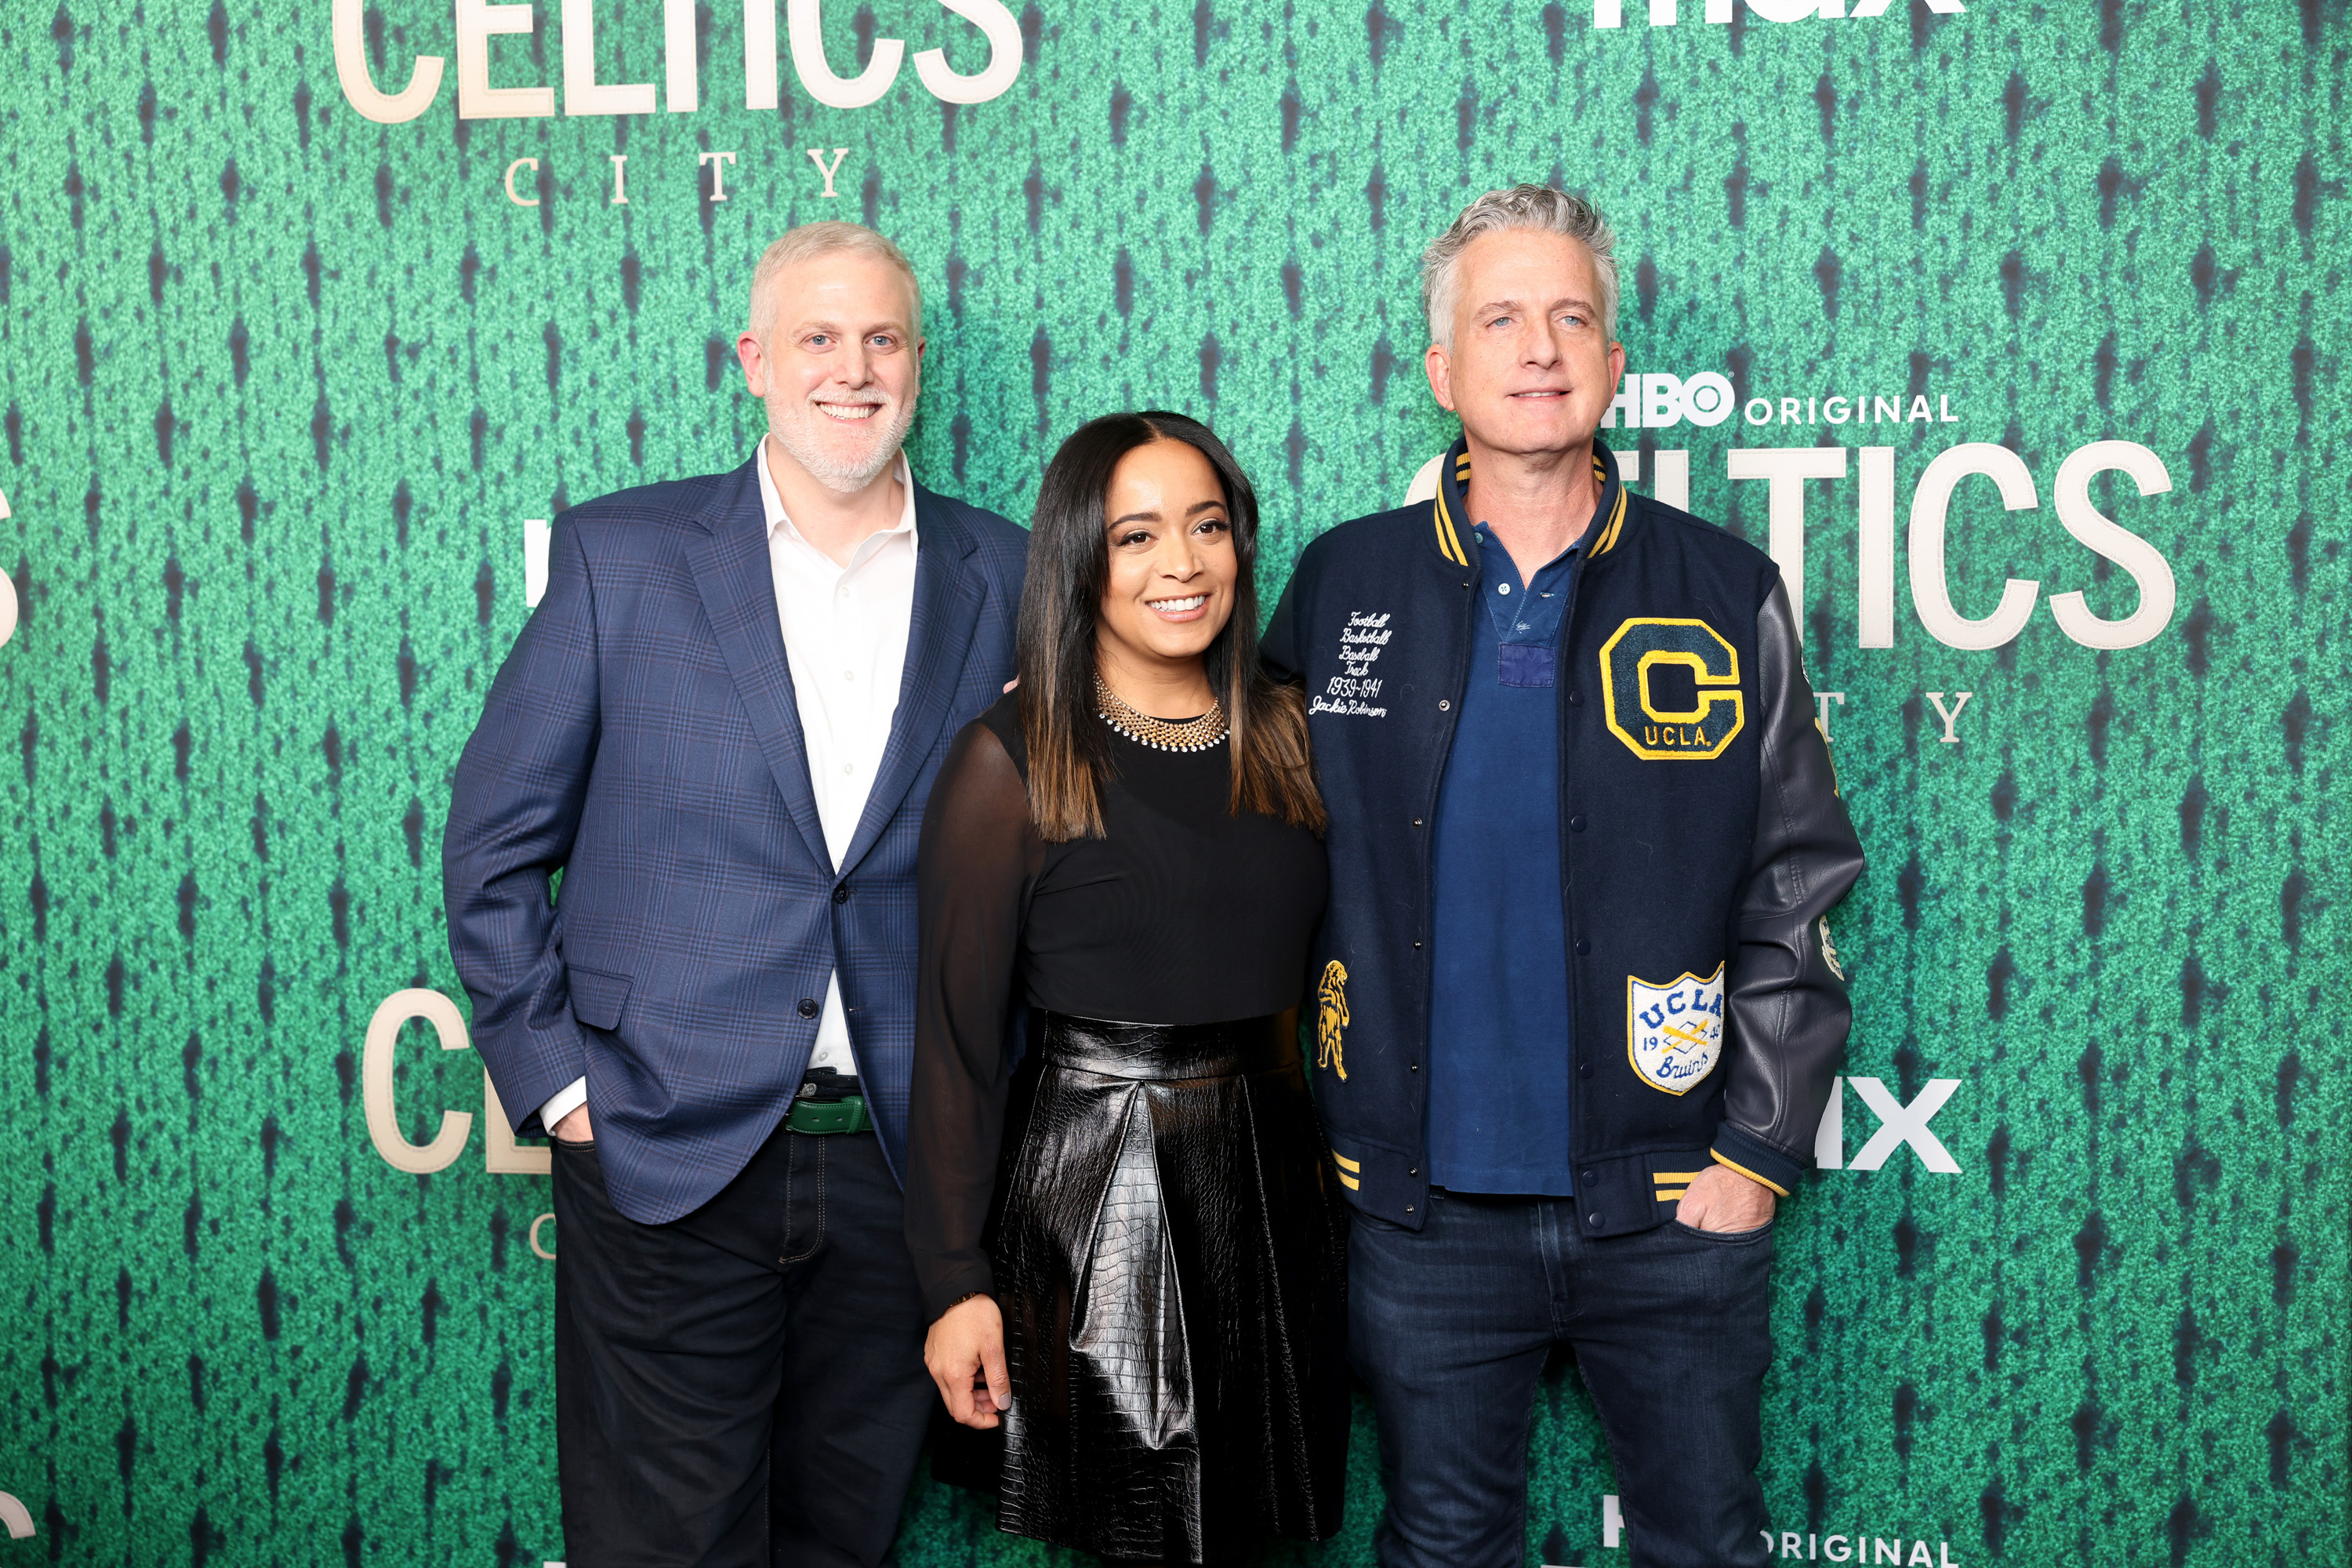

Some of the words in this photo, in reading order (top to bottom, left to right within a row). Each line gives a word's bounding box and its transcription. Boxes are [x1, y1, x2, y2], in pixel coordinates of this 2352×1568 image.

[504, 147, 849, 207] CITY
[1600, 370, 1736, 429] HBO
[1744, 394, 1959, 426] ORIGINAL
[1348, 612, 1391, 628] Football
[1339, 628, 1392, 645] Basketball
[1338, 645, 1381, 662] Baseball
[1345, 661, 1369, 677] Track
[1599, 617, 1745, 760] C
[1308, 695, 1348, 715] Jackie
[1346, 699, 1388, 718] Robinson
[1645, 726, 1708, 746] UCLA
[1639, 989, 1723, 1029] UCLA
[1643, 1036, 1659, 1051] 19
[1656, 1052, 1708, 1079] Bruins
